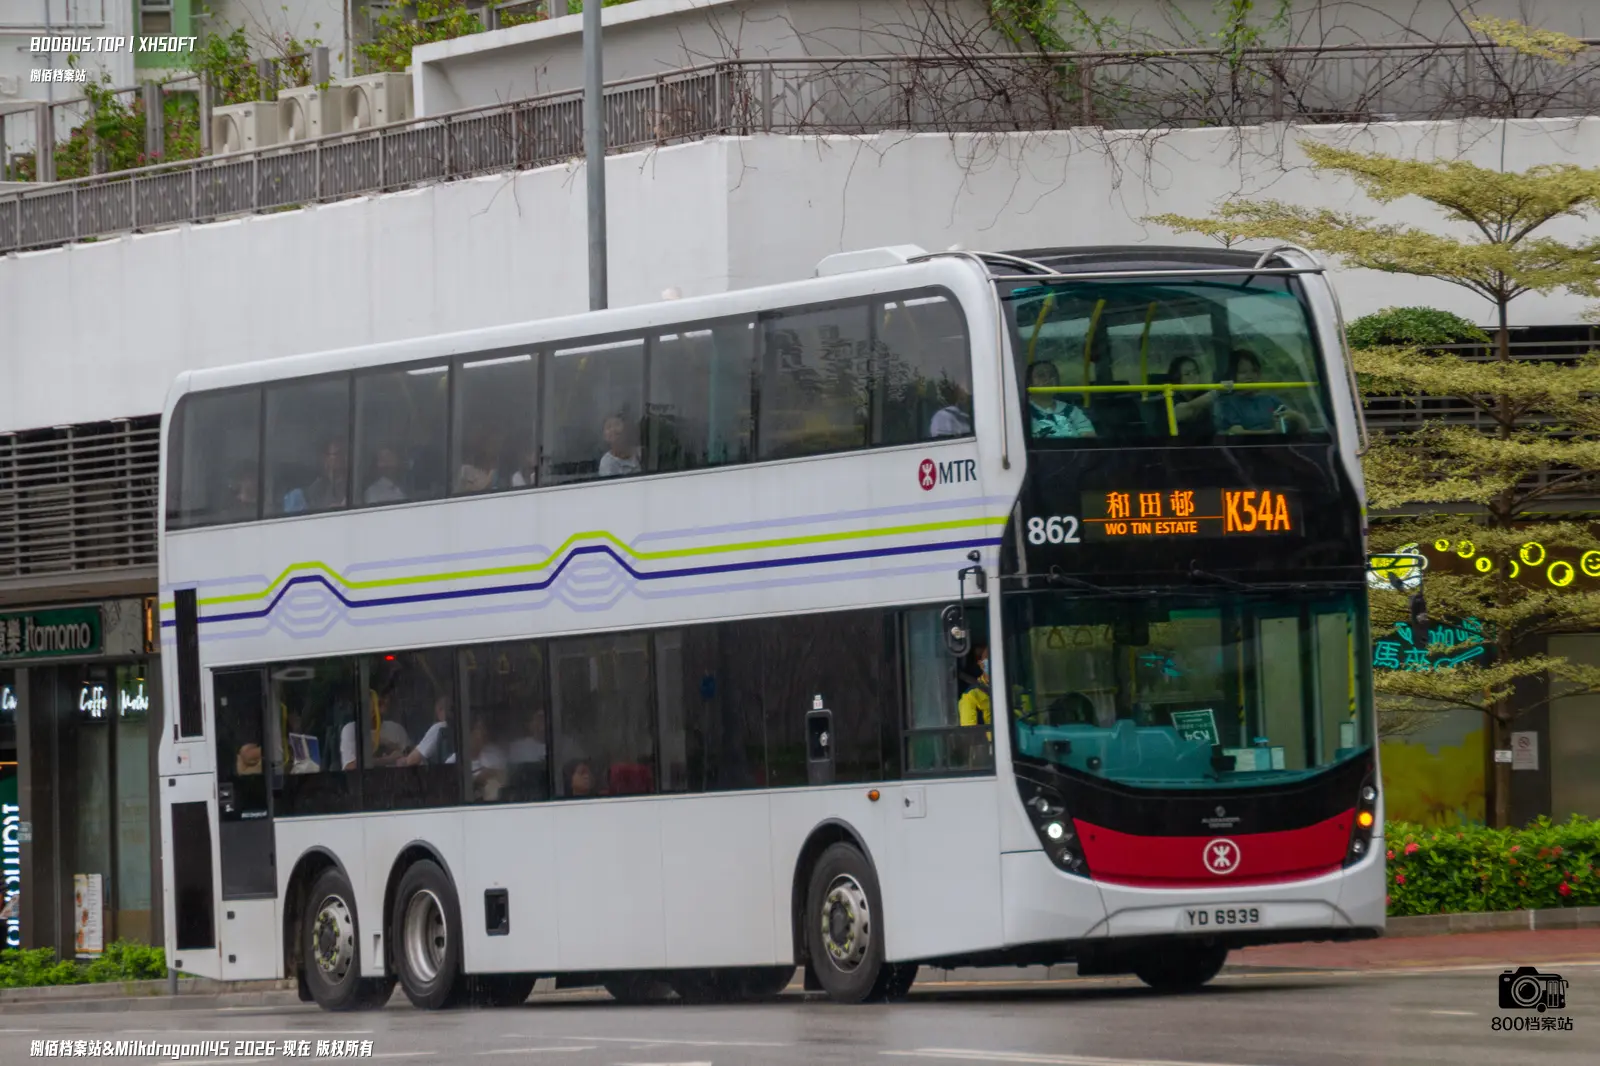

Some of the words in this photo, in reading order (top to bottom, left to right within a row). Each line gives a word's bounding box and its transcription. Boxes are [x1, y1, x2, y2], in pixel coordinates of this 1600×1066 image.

[939, 459, 977, 485] MTR
[1106, 490, 1195, 518] 和田邨
[1226, 490, 1291, 533] K54A
[1027, 515, 1081, 545] 862
[1105, 522, 1128, 535] WO
[1131, 522, 1152, 535] TIN
[1155, 521, 1198, 534] ESTATE
[1187, 910, 1209, 926] YD
[1215, 908, 1260, 925] 6939
